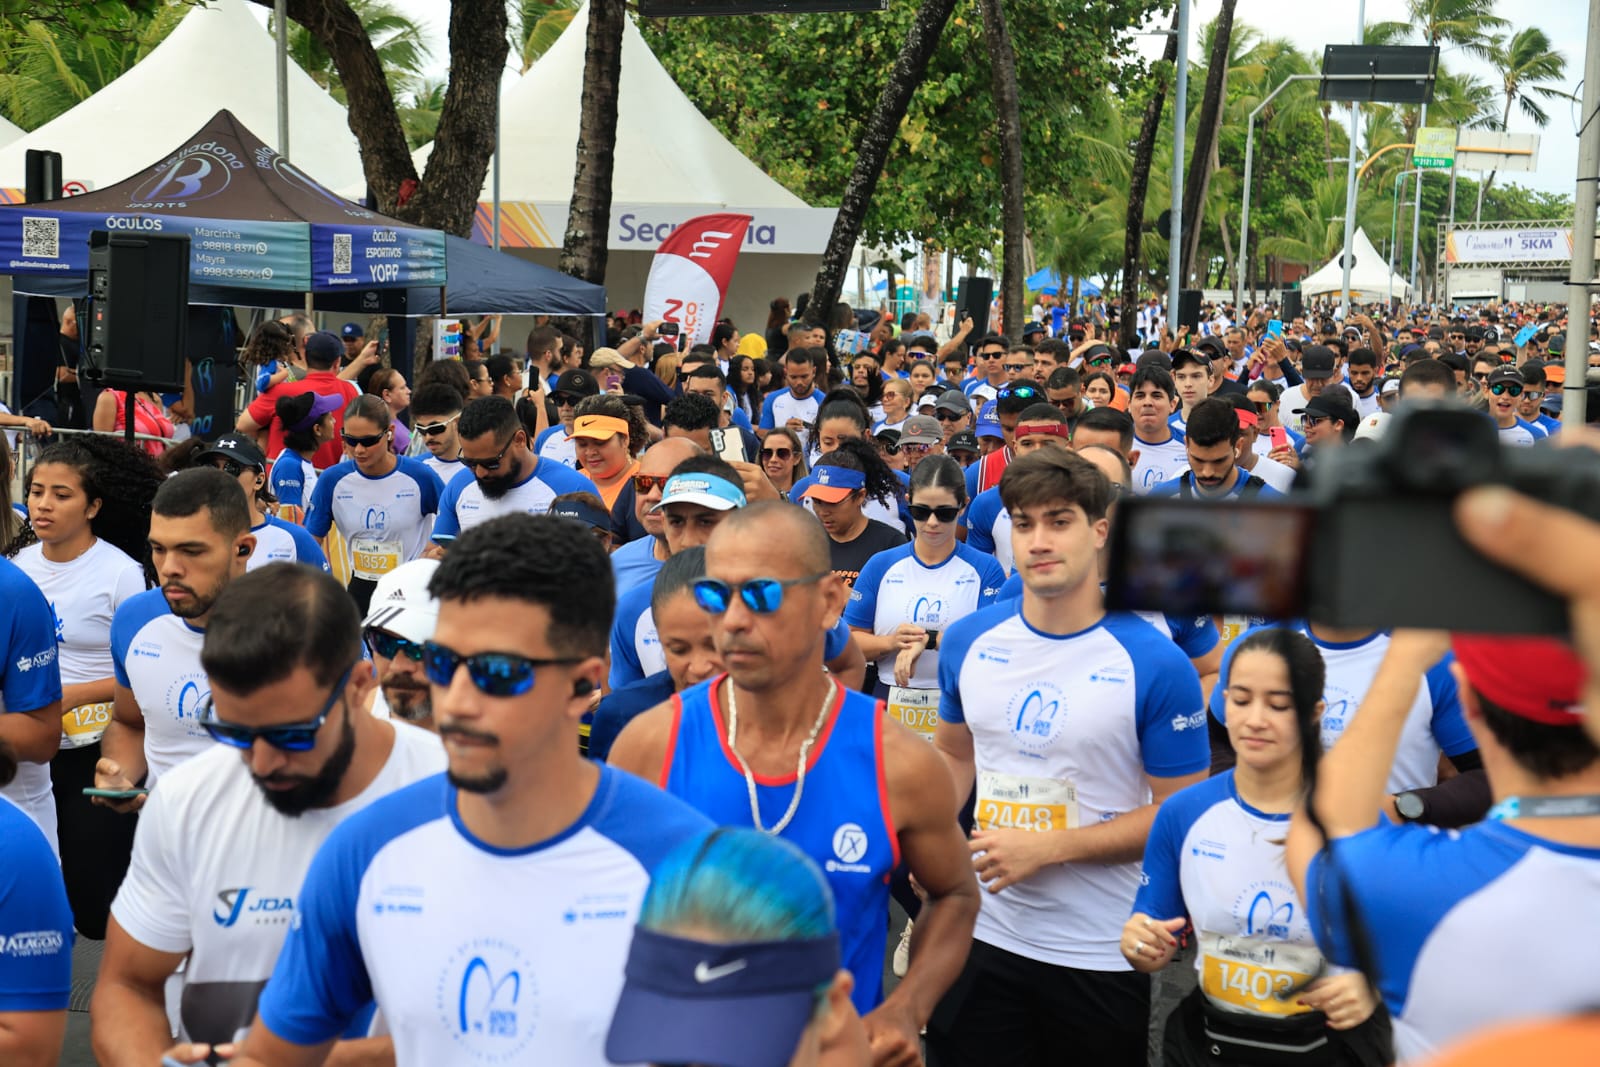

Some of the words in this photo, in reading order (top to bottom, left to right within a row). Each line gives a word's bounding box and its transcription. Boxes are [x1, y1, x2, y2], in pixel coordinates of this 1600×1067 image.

[106, 215, 163, 230] ÓCULOS
[194, 227, 241, 239] Marcinha
[372, 229, 397, 242] ÓCULOS
[202, 240, 256, 253] 98818-8371
[1521, 239, 1553, 250] 5KM
[195, 253, 226, 265] Mayra
[365, 247, 402, 258] ESPORTIVOS
[369, 263, 399, 283] YOPP
[359, 554, 388, 569] 1352
[71, 702, 115, 727] 128
[899, 707, 939, 727] 1078
[985, 802, 1053, 833] 2448
[1218, 962, 1295, 1002] 1403
